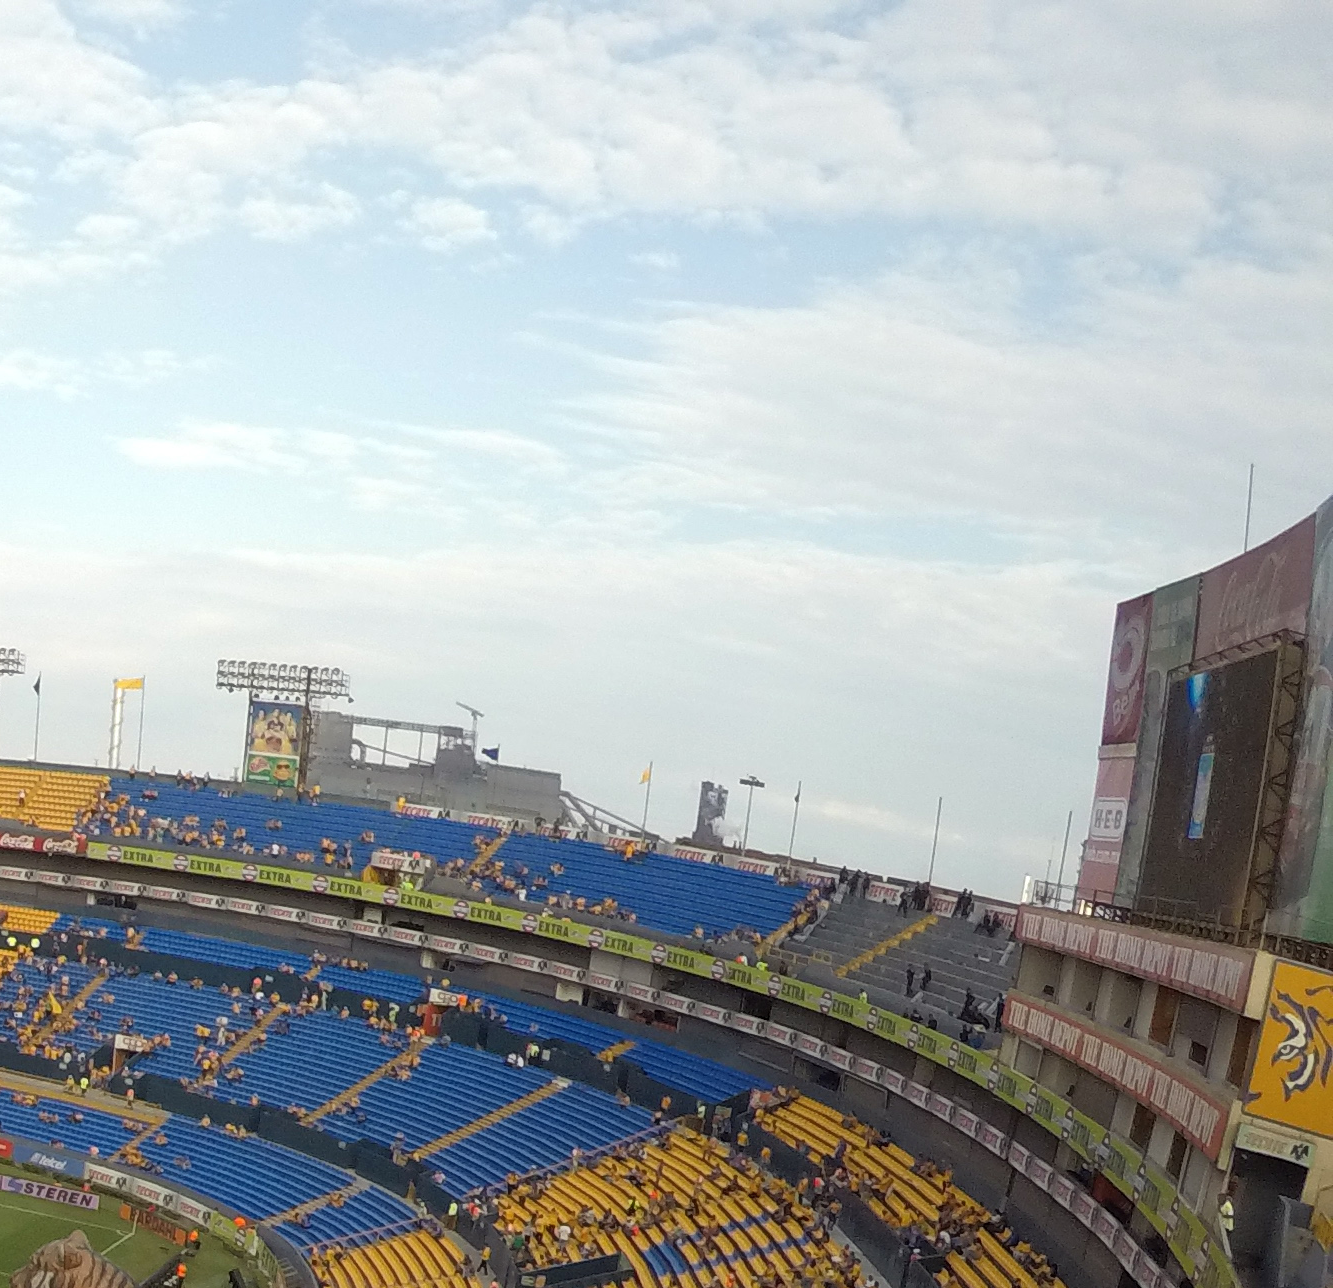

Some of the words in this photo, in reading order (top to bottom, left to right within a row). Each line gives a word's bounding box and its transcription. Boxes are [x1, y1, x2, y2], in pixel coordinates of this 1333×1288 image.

[123, 851, 154, 864] EXTRA
[190, 861, 221, 874] EXTRA
[260, 870, 291, 884] EXTRA
[330, 881, 362, 896] EXTRA
[400, 893, 433, 909] EXTRA
[470, 907, 502, 922] EXTRA
[538, 921, 569, 938] EXTRA
[604, 936, 633, 953] EXTRA
[667, 950, 695, 969] EXTRA
[88, 1168, 115, 1186] TECATE
[23, 1183, 93, 1208] STEREN
